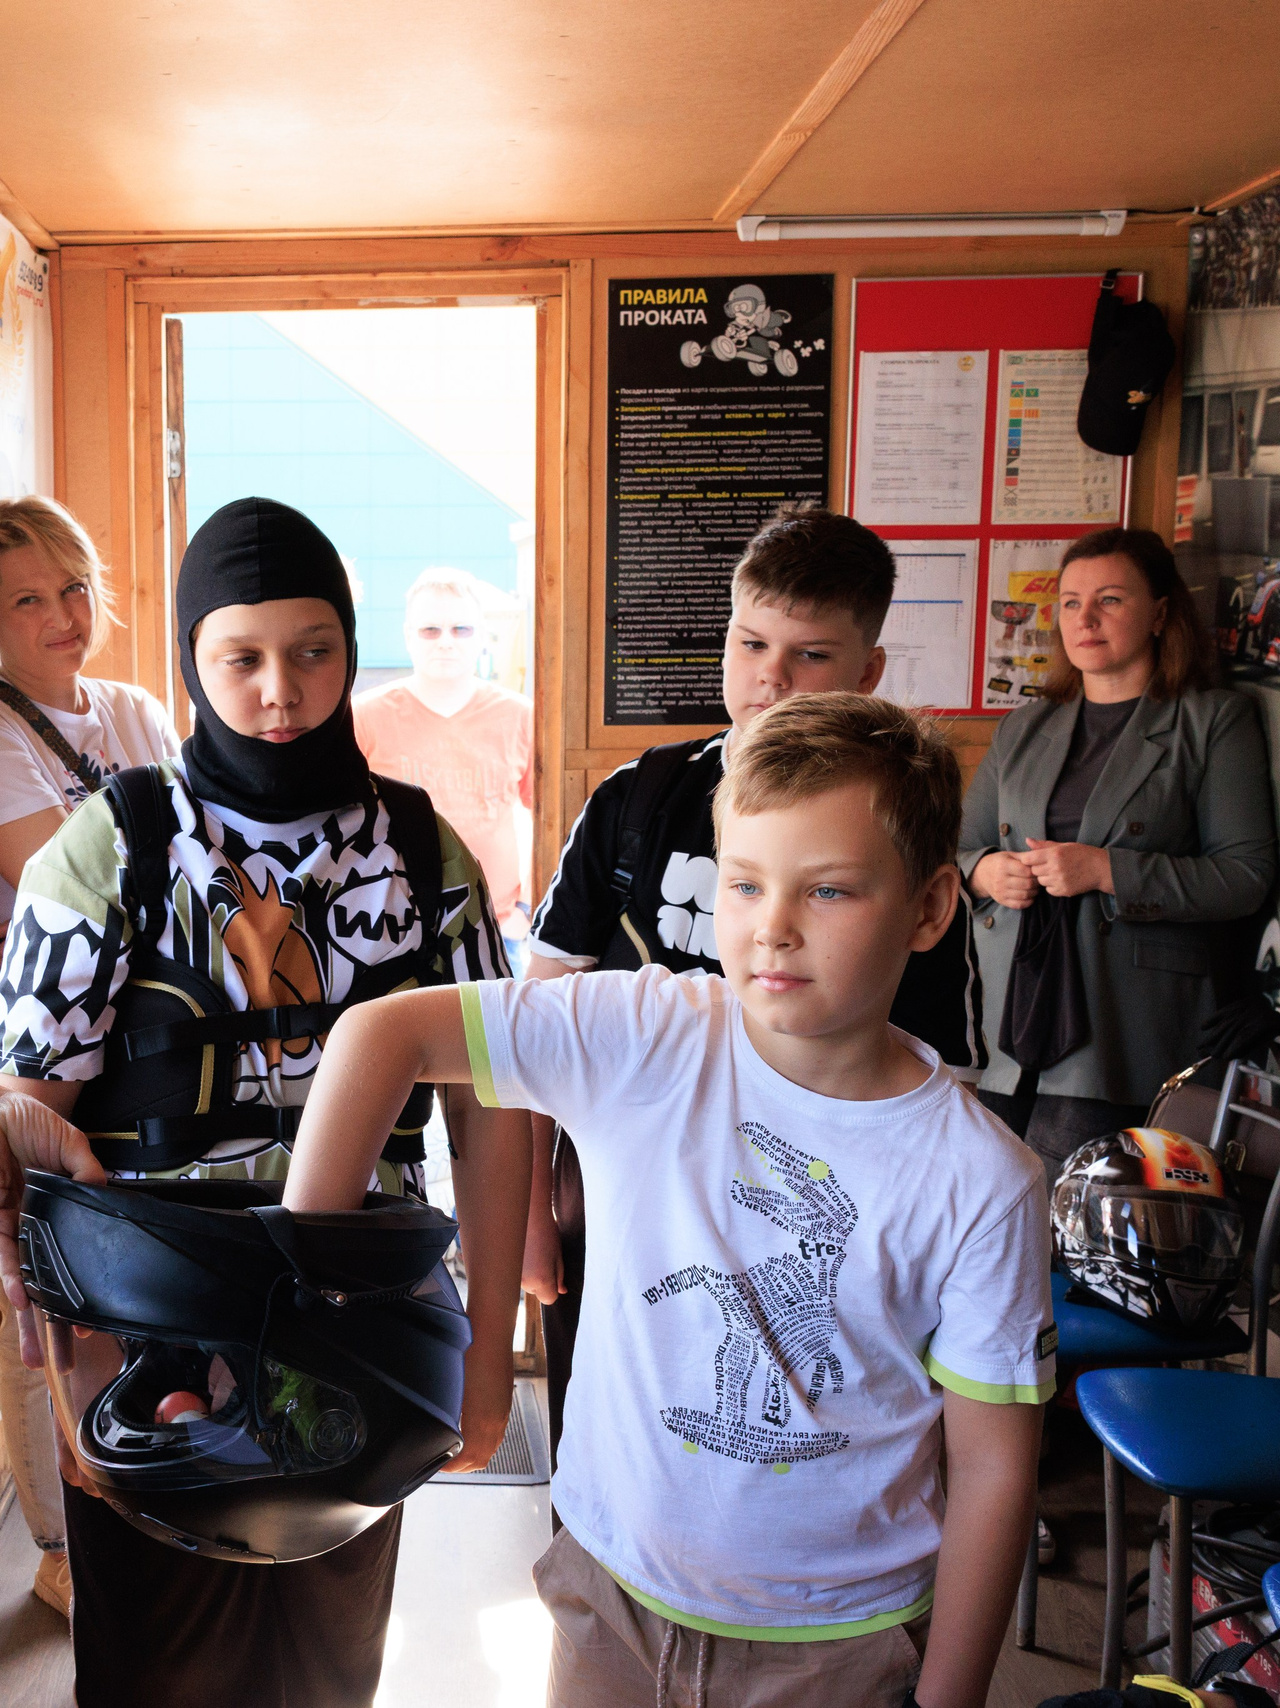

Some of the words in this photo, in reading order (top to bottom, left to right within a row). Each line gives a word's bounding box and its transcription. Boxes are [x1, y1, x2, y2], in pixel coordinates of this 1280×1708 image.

[620, 288, 708, 305] ПРАВИЛА
[620, 309, 708, 326] ПРОКАТА
[798, 1239, 844, 1260] t-rex
[1259, 1654, 1272, 1677] 195
